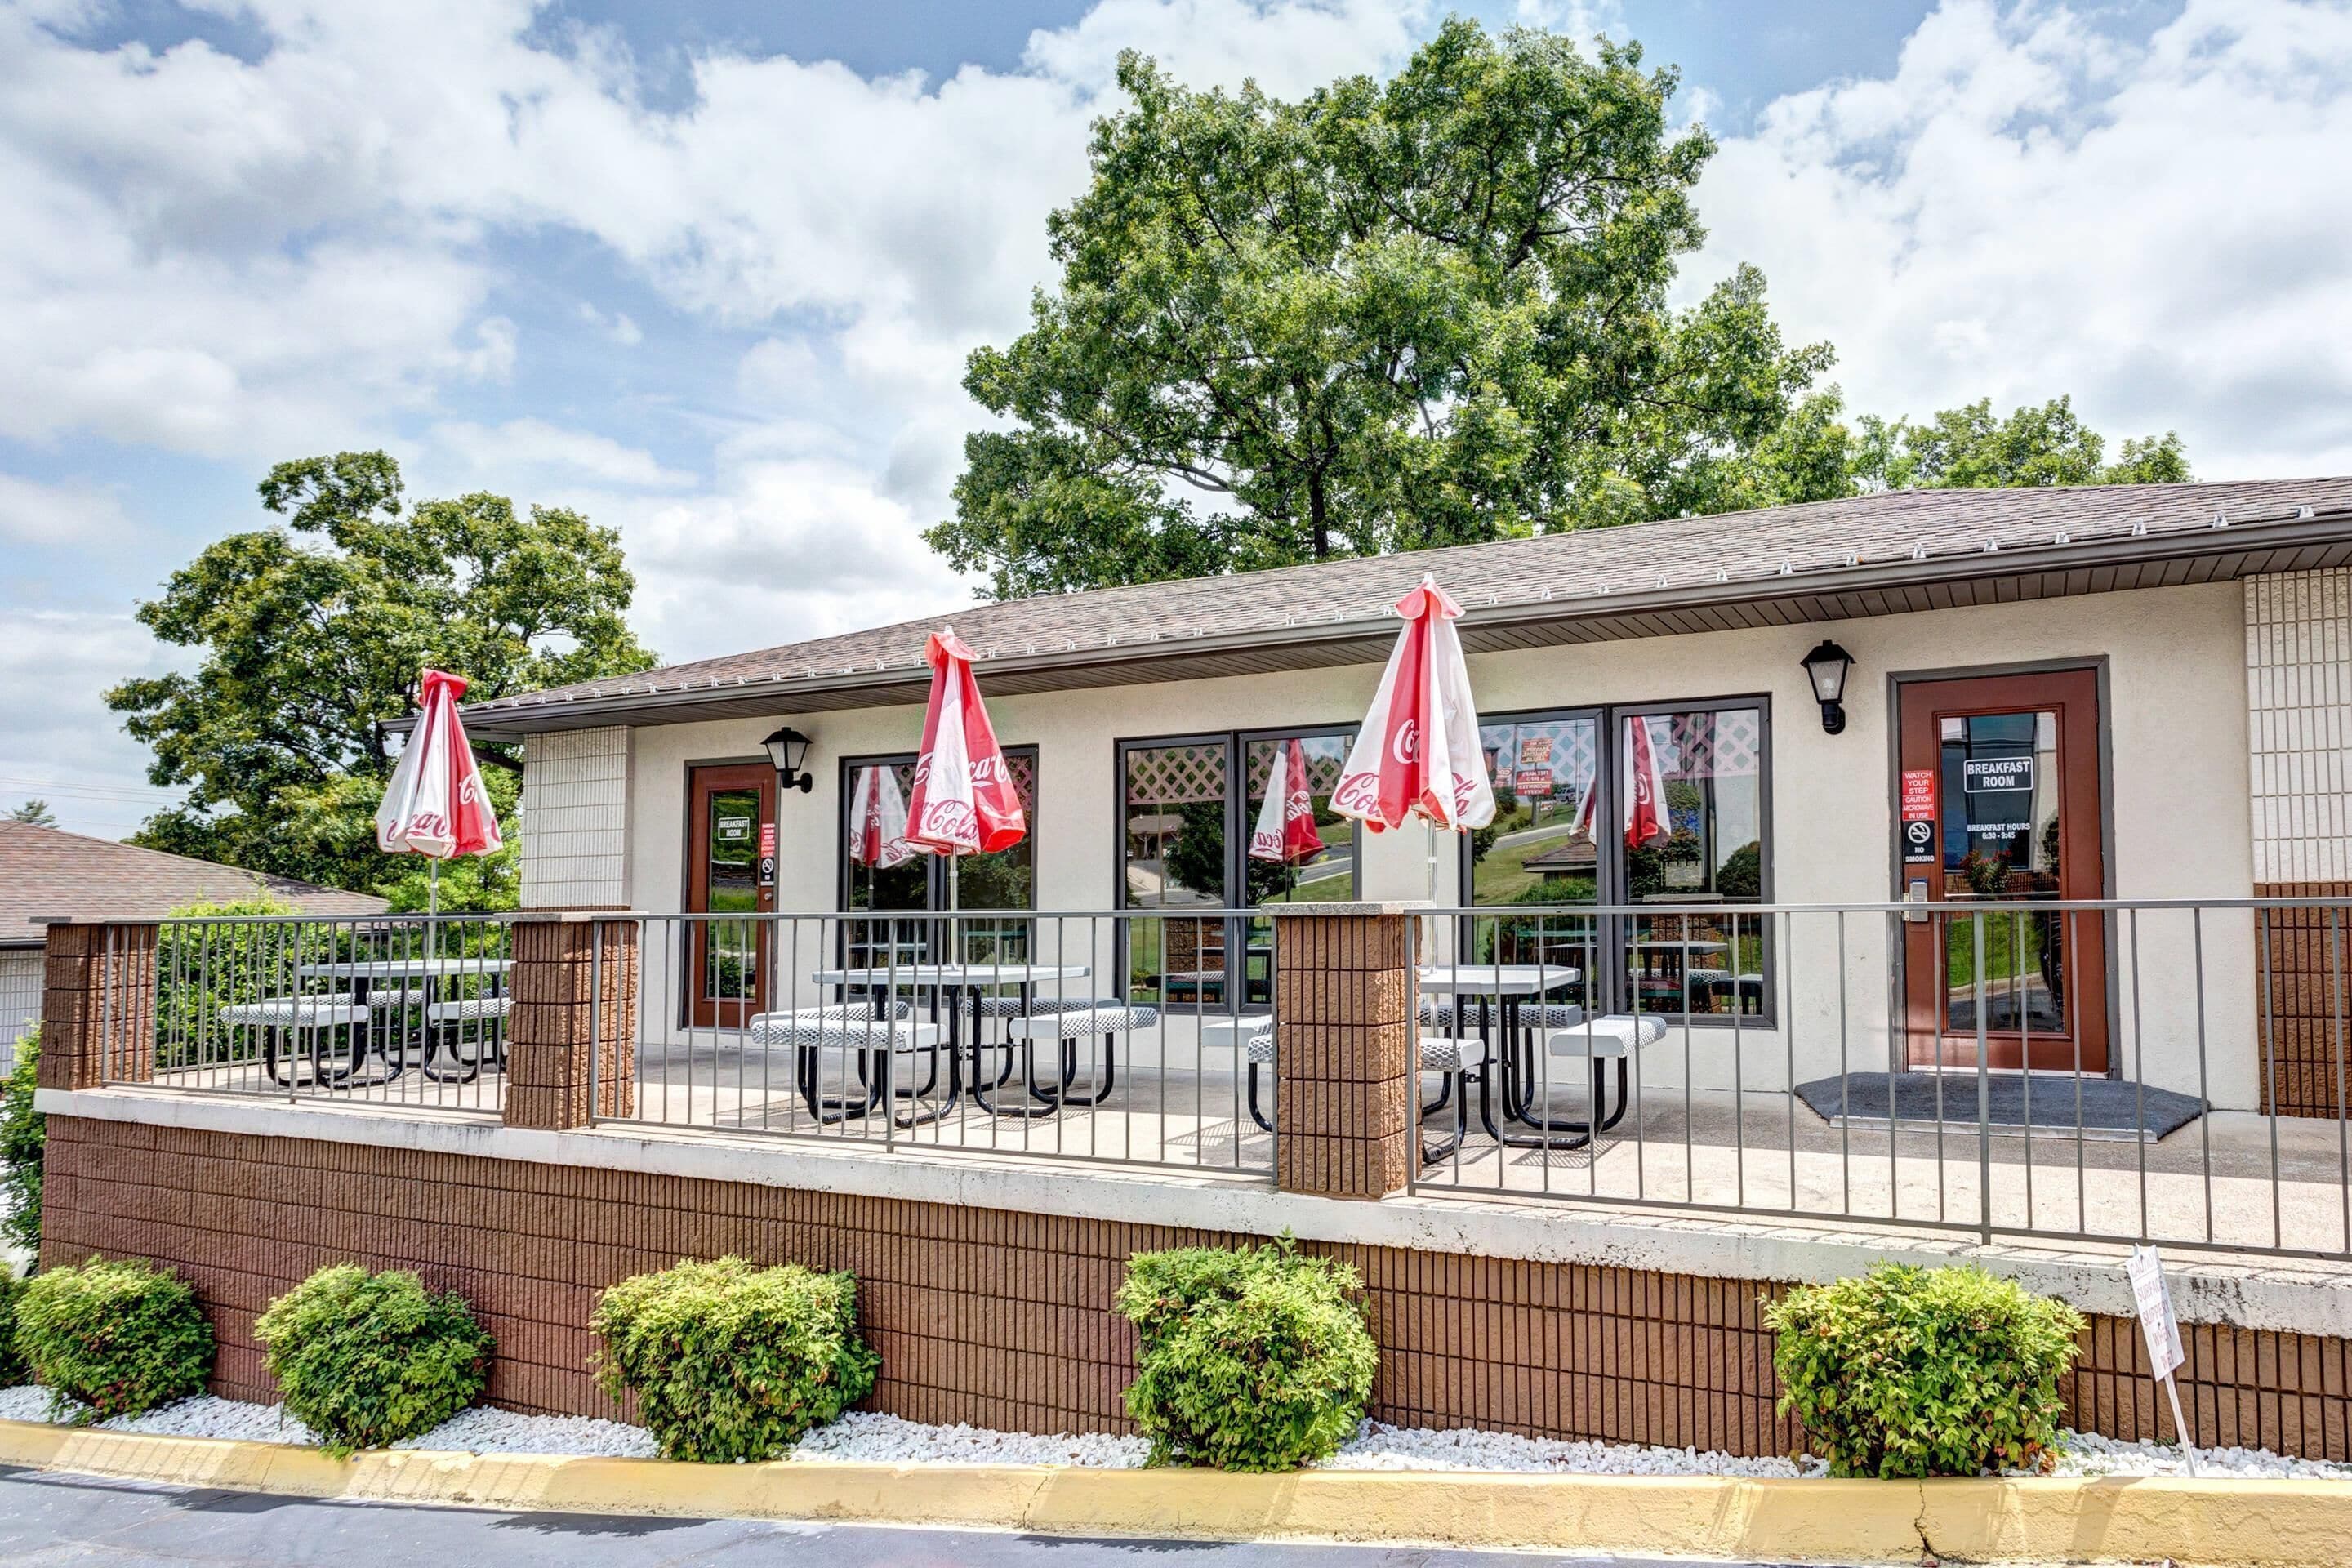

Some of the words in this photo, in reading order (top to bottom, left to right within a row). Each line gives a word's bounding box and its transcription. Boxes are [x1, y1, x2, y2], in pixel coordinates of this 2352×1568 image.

[1967, 761, 2029, 775] BREAKFAST
[1908, 779, 1929, 787] YOUR
[1983, 776, 2015, 787] ROOM
[719, 820, 747, 828] BREAKFAST
[2130, 1254, 2158, 1276] CAUTION
[2142, 1299, 2170, 1327] SLIPPERY
[2152, 1325, 2172, 1347] WHEN
[2160, 1348, 2175, 1370] WET
